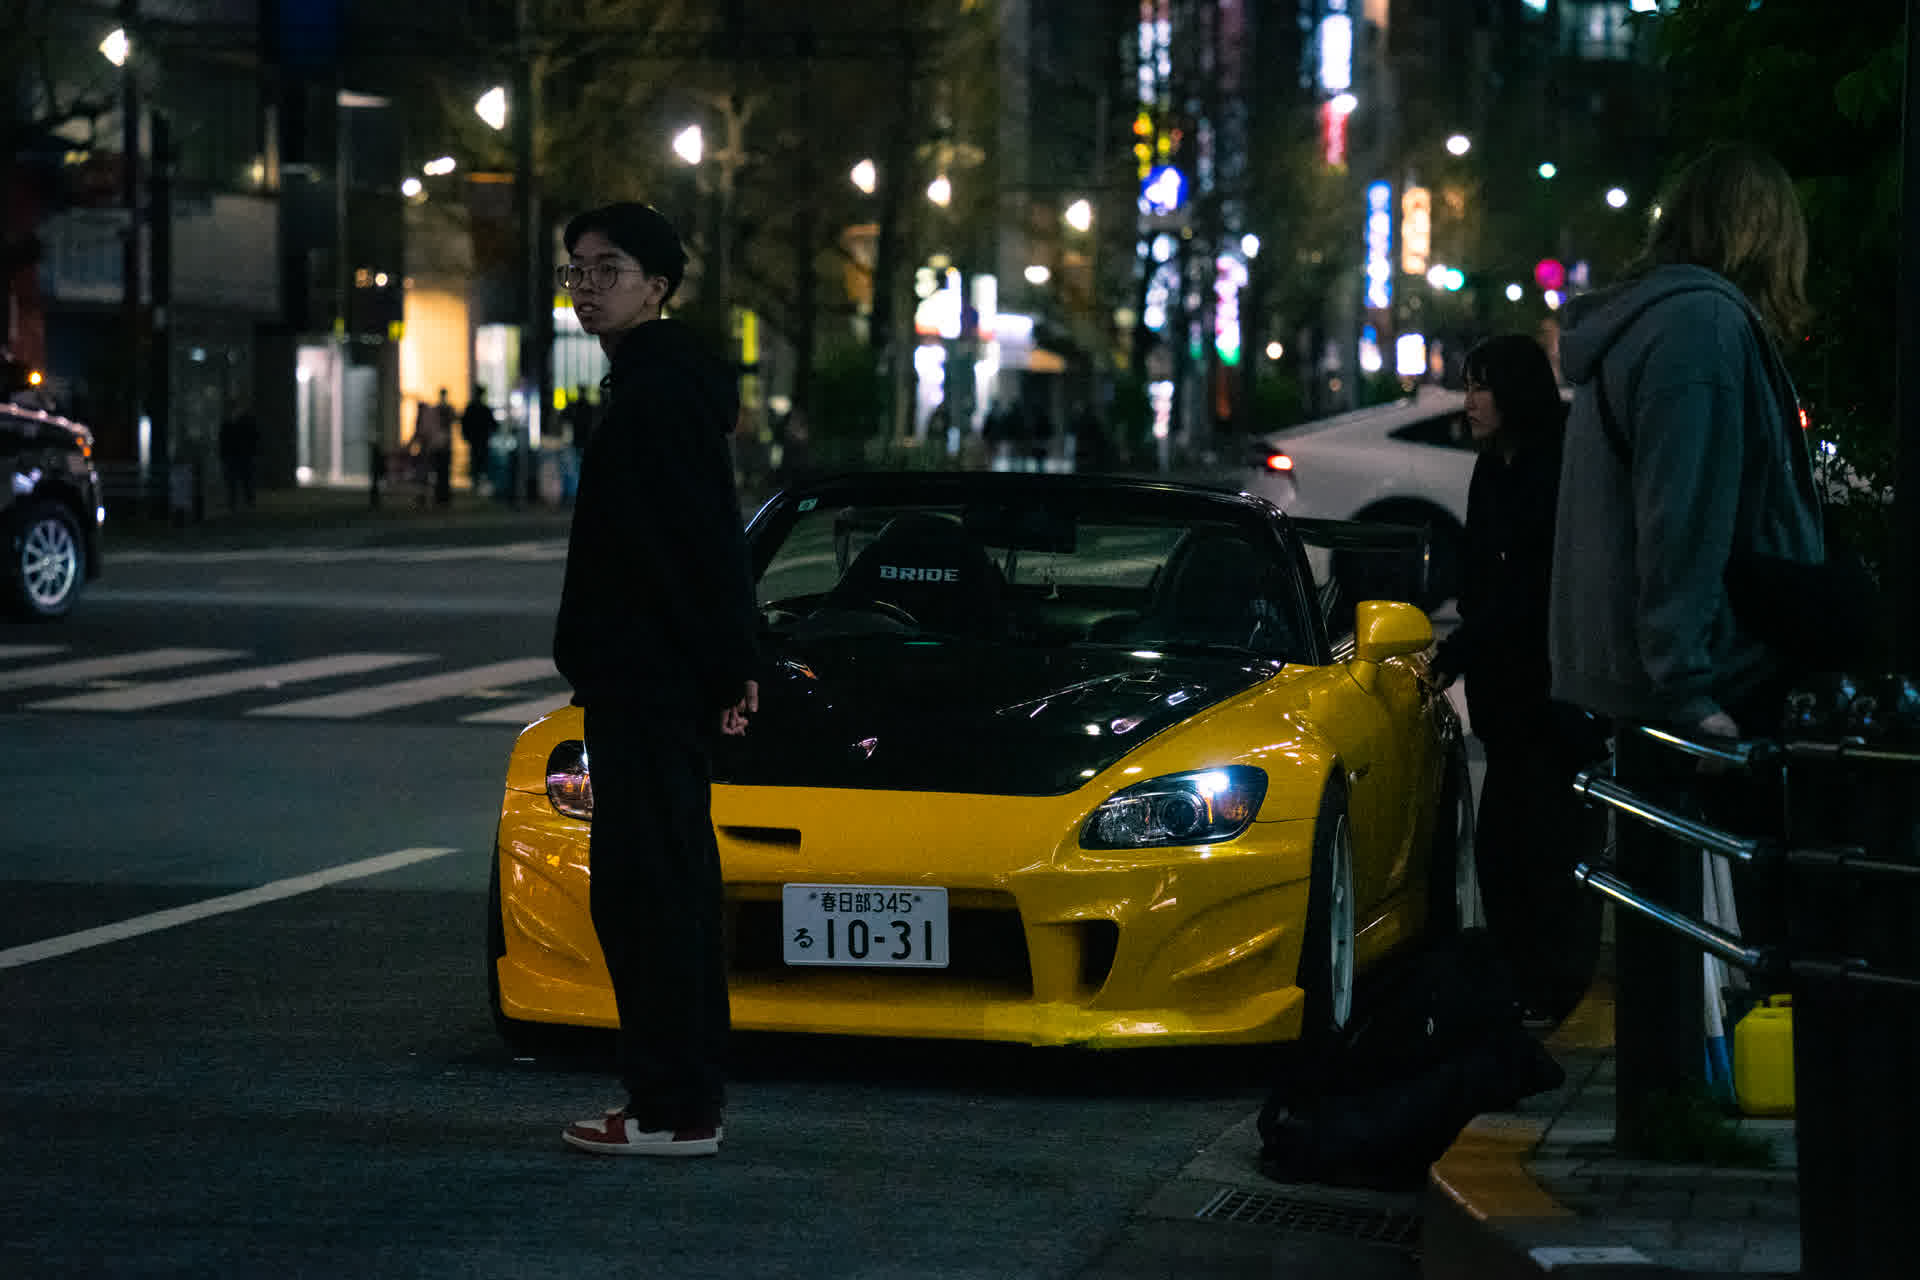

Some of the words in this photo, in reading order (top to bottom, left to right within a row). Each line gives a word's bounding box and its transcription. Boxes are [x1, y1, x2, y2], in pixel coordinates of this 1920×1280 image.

[880, 565, 960, 581] BRIDE
[821, 892, 913, 913] 春日部345
[793, 928, 814, 949] る
[827, 919, 932, 960] 10-31
